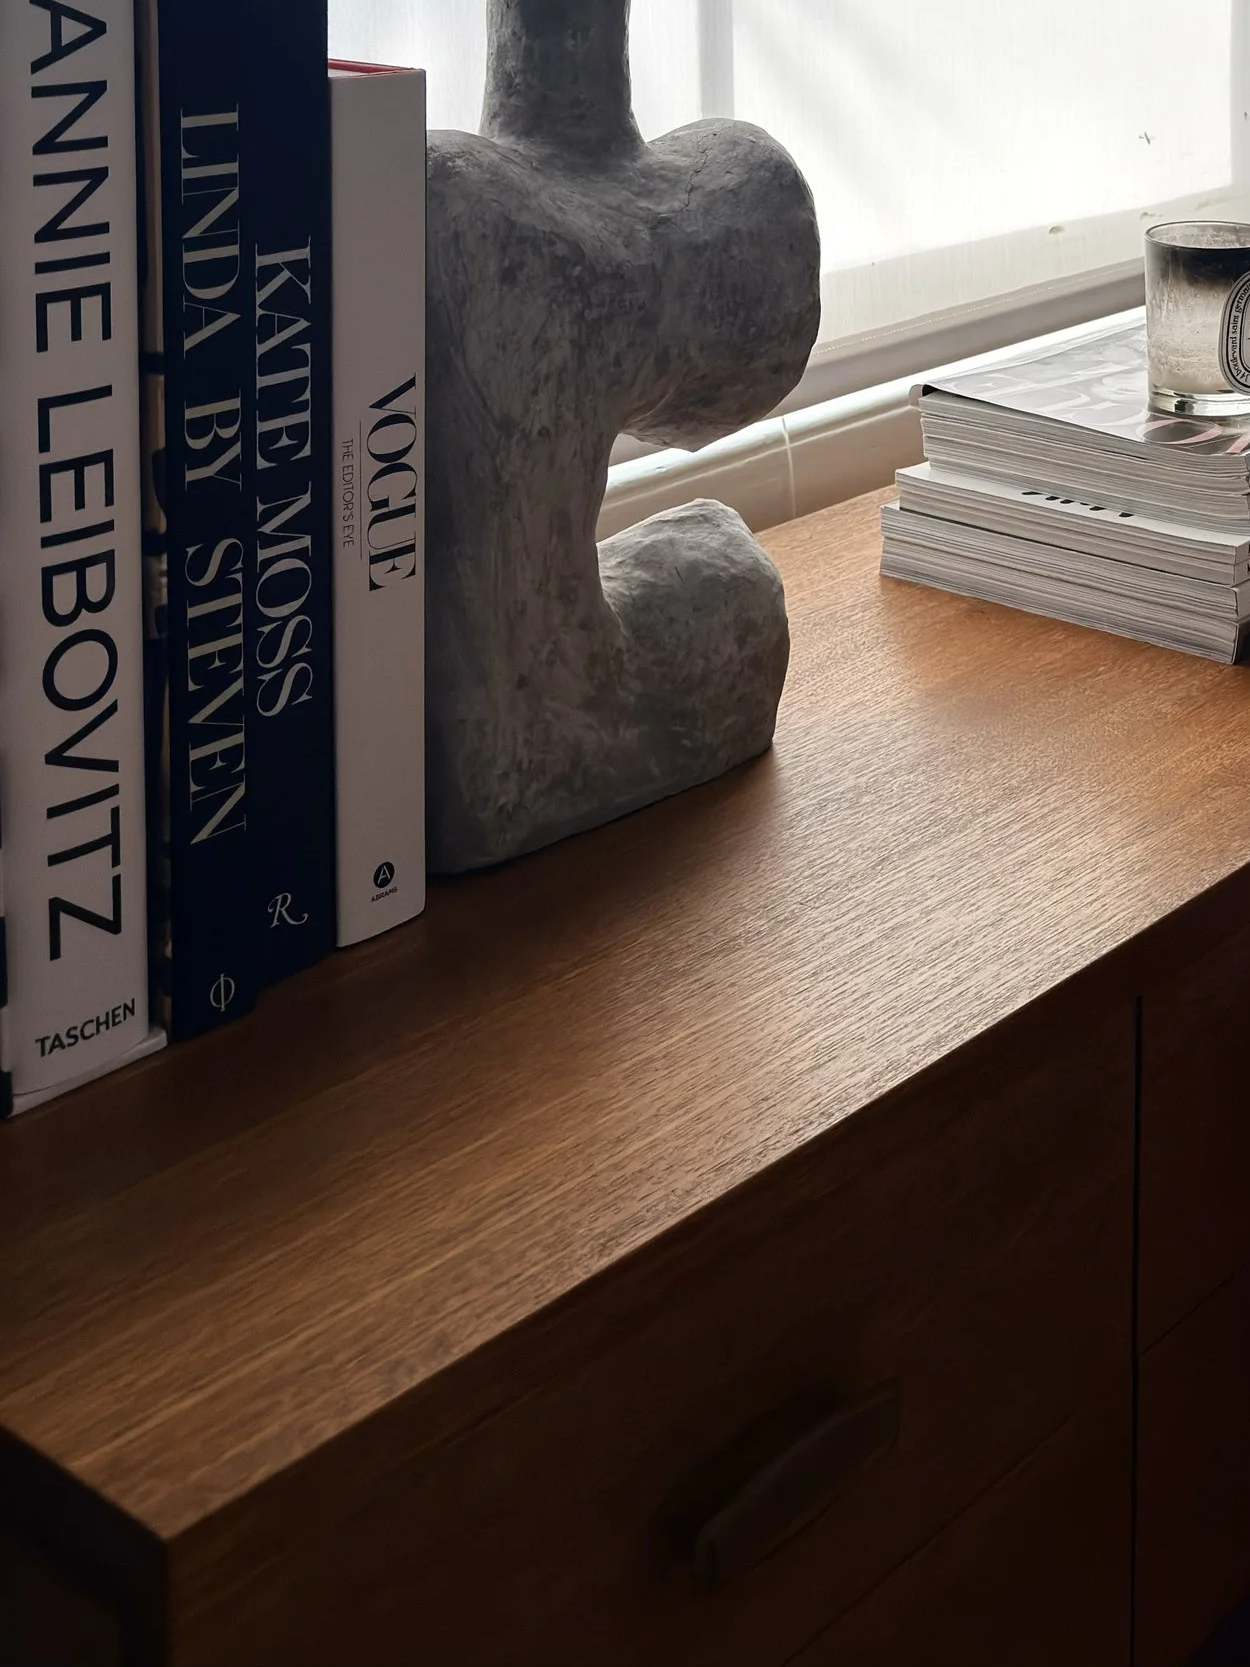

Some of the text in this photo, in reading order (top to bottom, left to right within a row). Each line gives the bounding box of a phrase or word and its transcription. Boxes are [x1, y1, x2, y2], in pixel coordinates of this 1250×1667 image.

[180, 102, 247, 845] LINDA BY STEVEN
[254, 235, 313, 718] KATE MOSS
[342, 438, 355, 548] THE EDITOR'S EYE
[367, 372, 417, 591] VOGUE
[37, 384, 122, 961] LEIBOVITZ
[35, 997, 136, 1058] TASCHEN
